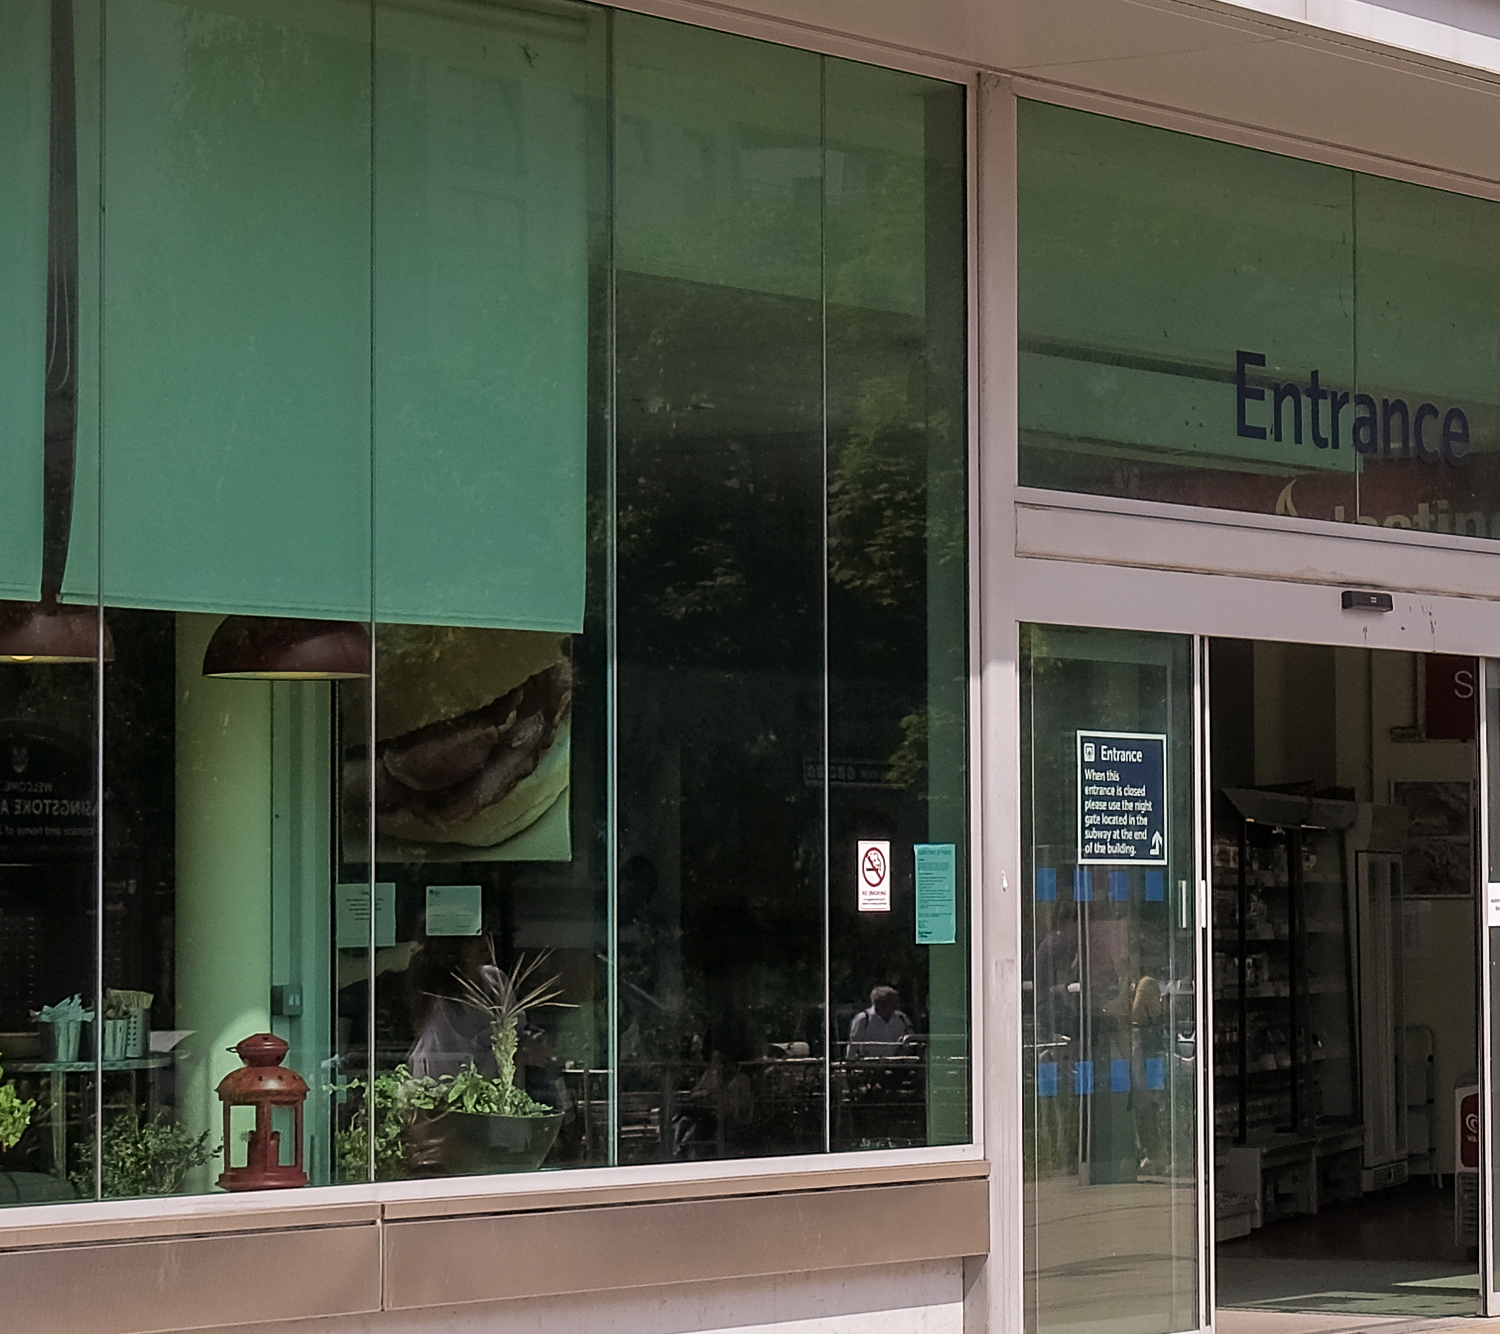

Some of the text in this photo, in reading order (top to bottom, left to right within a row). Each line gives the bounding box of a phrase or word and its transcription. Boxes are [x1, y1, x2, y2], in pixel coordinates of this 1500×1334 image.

[1236, 349, 1471, 468] Entrance
[1100, 745, 1142, 762] Entrance
[1084, 768, 1119, 781] When this
[1085, 784, 1145, 797] entrance is closed
[1085, 799, 1107, 813] please
[1108, 801, 1121, 811] use
[1122, 799, 1133, 811] the
[1085, 813, 1148, 827] gate located in the
[1085, 827, 1147, 842] subway at the end
[1085, 841, 1093, 854] of
[1094, 842, 1106, 854] the
